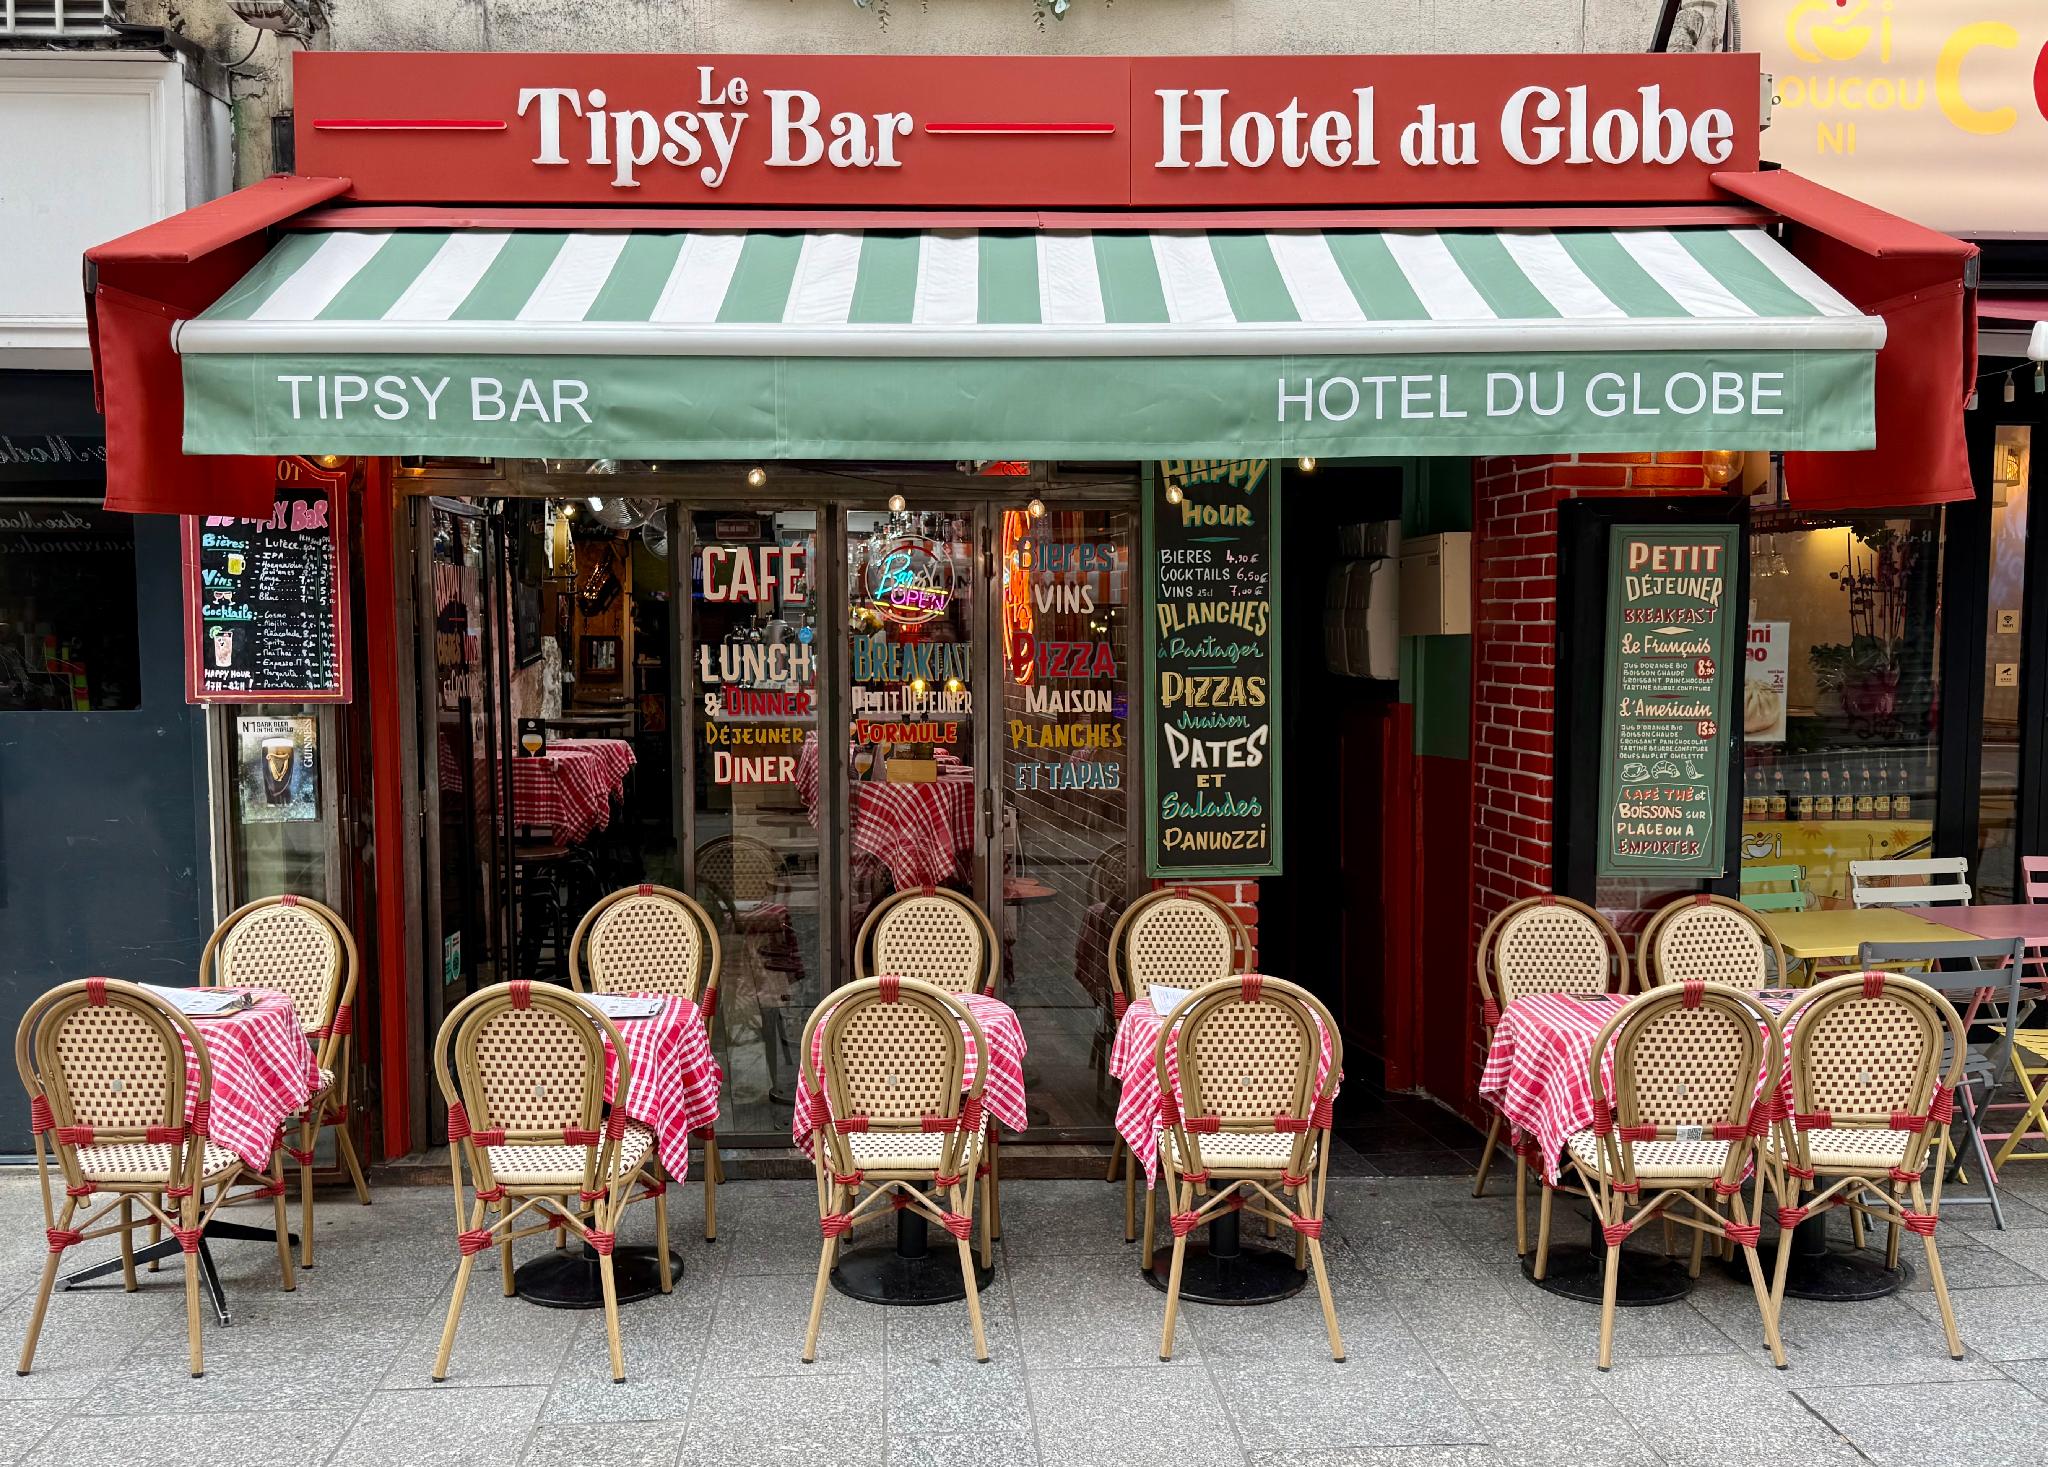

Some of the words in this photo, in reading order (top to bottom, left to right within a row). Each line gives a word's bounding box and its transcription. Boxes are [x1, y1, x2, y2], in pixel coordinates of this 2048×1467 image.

[697, 66, 749, 106] Le
[1777, 75, 1926, 110] OUCOU
[517, 87, 749, 188] Tipsy
[763, 89, 914, 168] Bar
[1154, 85, 1381, 168] Hotel
[1400, 104, 1479, 166] du
[1500, 84, 1735, 166] Globe
[1816, 121, 1856, 155] NI
[277, 375, 451, 420] TIPSY
[470, 377, 593, 423] BAR
[1277, 374, 1468, 422] HOTEL
[1485, 371, 1565, 417] DU
[1585, 371, 1785, 417] GLOBE
[1181, 499, 1255, 527] HOUR
[1160, 549, 1212, 564] BIERES
[1628, 542, 1722, 573] PETIT
[702, 541, 807, 602] CAFÉ
[1160, 565, 1230, 581] COCKTAILS
[891, 587, 945, 611] OPEN
[1035, 584, 1095, 614] VINS
[1161, 583, 1193, 598] VINS
[1625, 573, 1723, 608] DÉJEUNER
[1157, 601, 1270, 639] PLANCHES
[1624, 608, 1718, 624] BREAKFAST
[1621, 633, 1641, 654] Le
[1644, 636, 1711, 657] Français
[1746, 623, 1771, 643] ini
[700, 644, 812, 683] LUNCH
[854, 635, 972, 682] BREAKFAST
[1011, 632, 1118, 680] PIZZA
[1170, 636, 1264, 663] Partager
[1746, 647, 1768, 662] ao
[204, 669, 229, 680] HAPPY
[231, 670, 251, 678] HOUR
[704, 692, 721, 717] &
[726, 688, 812, 716] DINNER
[852, 685, 899, 714] PETIT
[1025, 685, 1112, 713] MAISON
[1160, 671, 1266, 708] PIZZAS
[706, 721, 804, 745] DÉJEUNER
[856, 719, 958, 745] FORMULE
[1011, 719, 1121, 749] PLANCHES
[1177, 710, 1250, 730] Maison
[303, 719, 314, 768] GUINNESS
[1164, 722, 1269, 769] PATES
[714, 751, 798, 784] DINER
[1014, 762, 1041, 791] ET
[1045, 762, 1120, 790] TAPAS
[1196, 774, 1226, 788] ET
[1161, 791, 1262, 820] Salades
[1624, 787, 1660, 800] CAFÉ
[1664, 786, 1694, 801] THÉ
[1694, 789, 1706, 800] et
[1617, 823, 1663, 835] PLACE
[1686, 824, 1694, 836] A
